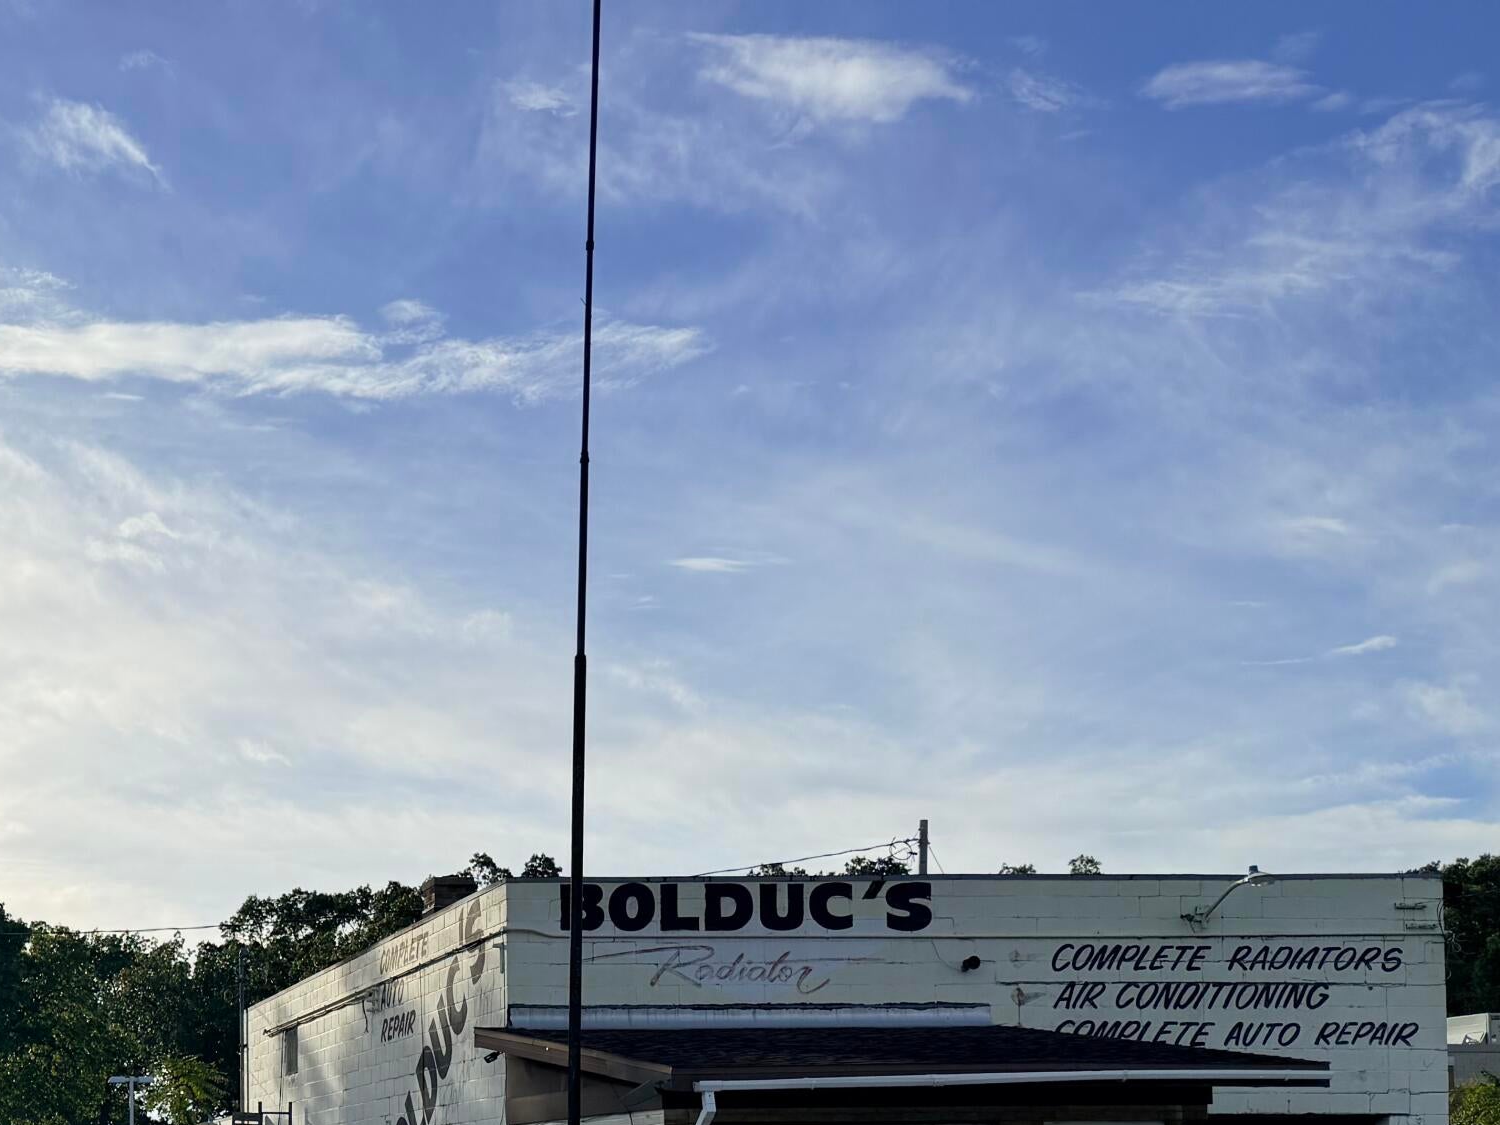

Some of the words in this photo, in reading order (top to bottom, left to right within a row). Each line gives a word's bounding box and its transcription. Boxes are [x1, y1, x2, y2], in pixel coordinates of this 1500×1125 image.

[559, 880, 932, 931] BOLDUC'S
[380, 931, 429, 975] COMPLETE
[1051, 943, 1212, 972] COMPLETE
[1227, 945, 1404, 973] RADIATORS
[583, 945, 832, 995] Radiator
[380, 980, 406, 1012] AUTO
[1052, 981, 1107, 1010] AIR
[1115, 982, 1331, 1010] CONDITIONING
[380, 1009, 417, 1043] REPAIR
[1223, 1021, 1301, 1048] AUTO
[1314, 1021, 1420, 1048] REPAIR
